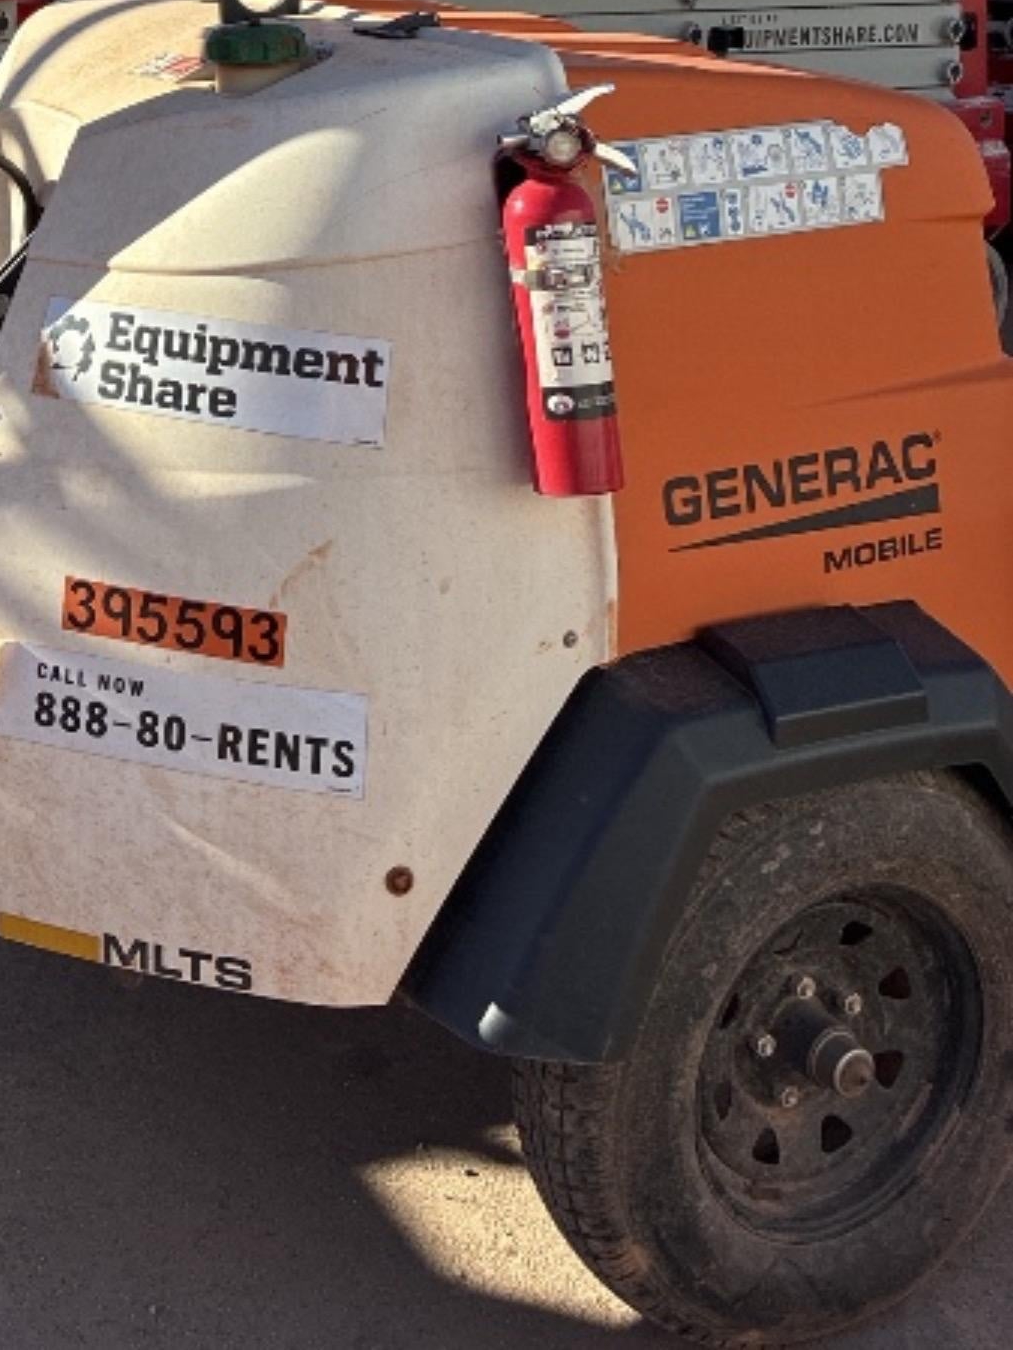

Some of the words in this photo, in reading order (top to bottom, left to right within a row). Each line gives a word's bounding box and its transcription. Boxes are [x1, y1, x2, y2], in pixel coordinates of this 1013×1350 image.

[744, 23, 920, 49] UIPMENTSHARE.COM
[104, 311, 384, 388] Equipment
[96, 359, 238, 418] Share
[662, 431, 937, 527] GENERAC
[823, 527, 943, 573] MOBILE
[65, 578, 281, 663] 395593
[36, 662, 88, 688] CALL
[97, 674, 145, 697] NOW
[33, 691, 356, 779] 888-80-RENTS
[102, 932, 253, 991] MLTS
